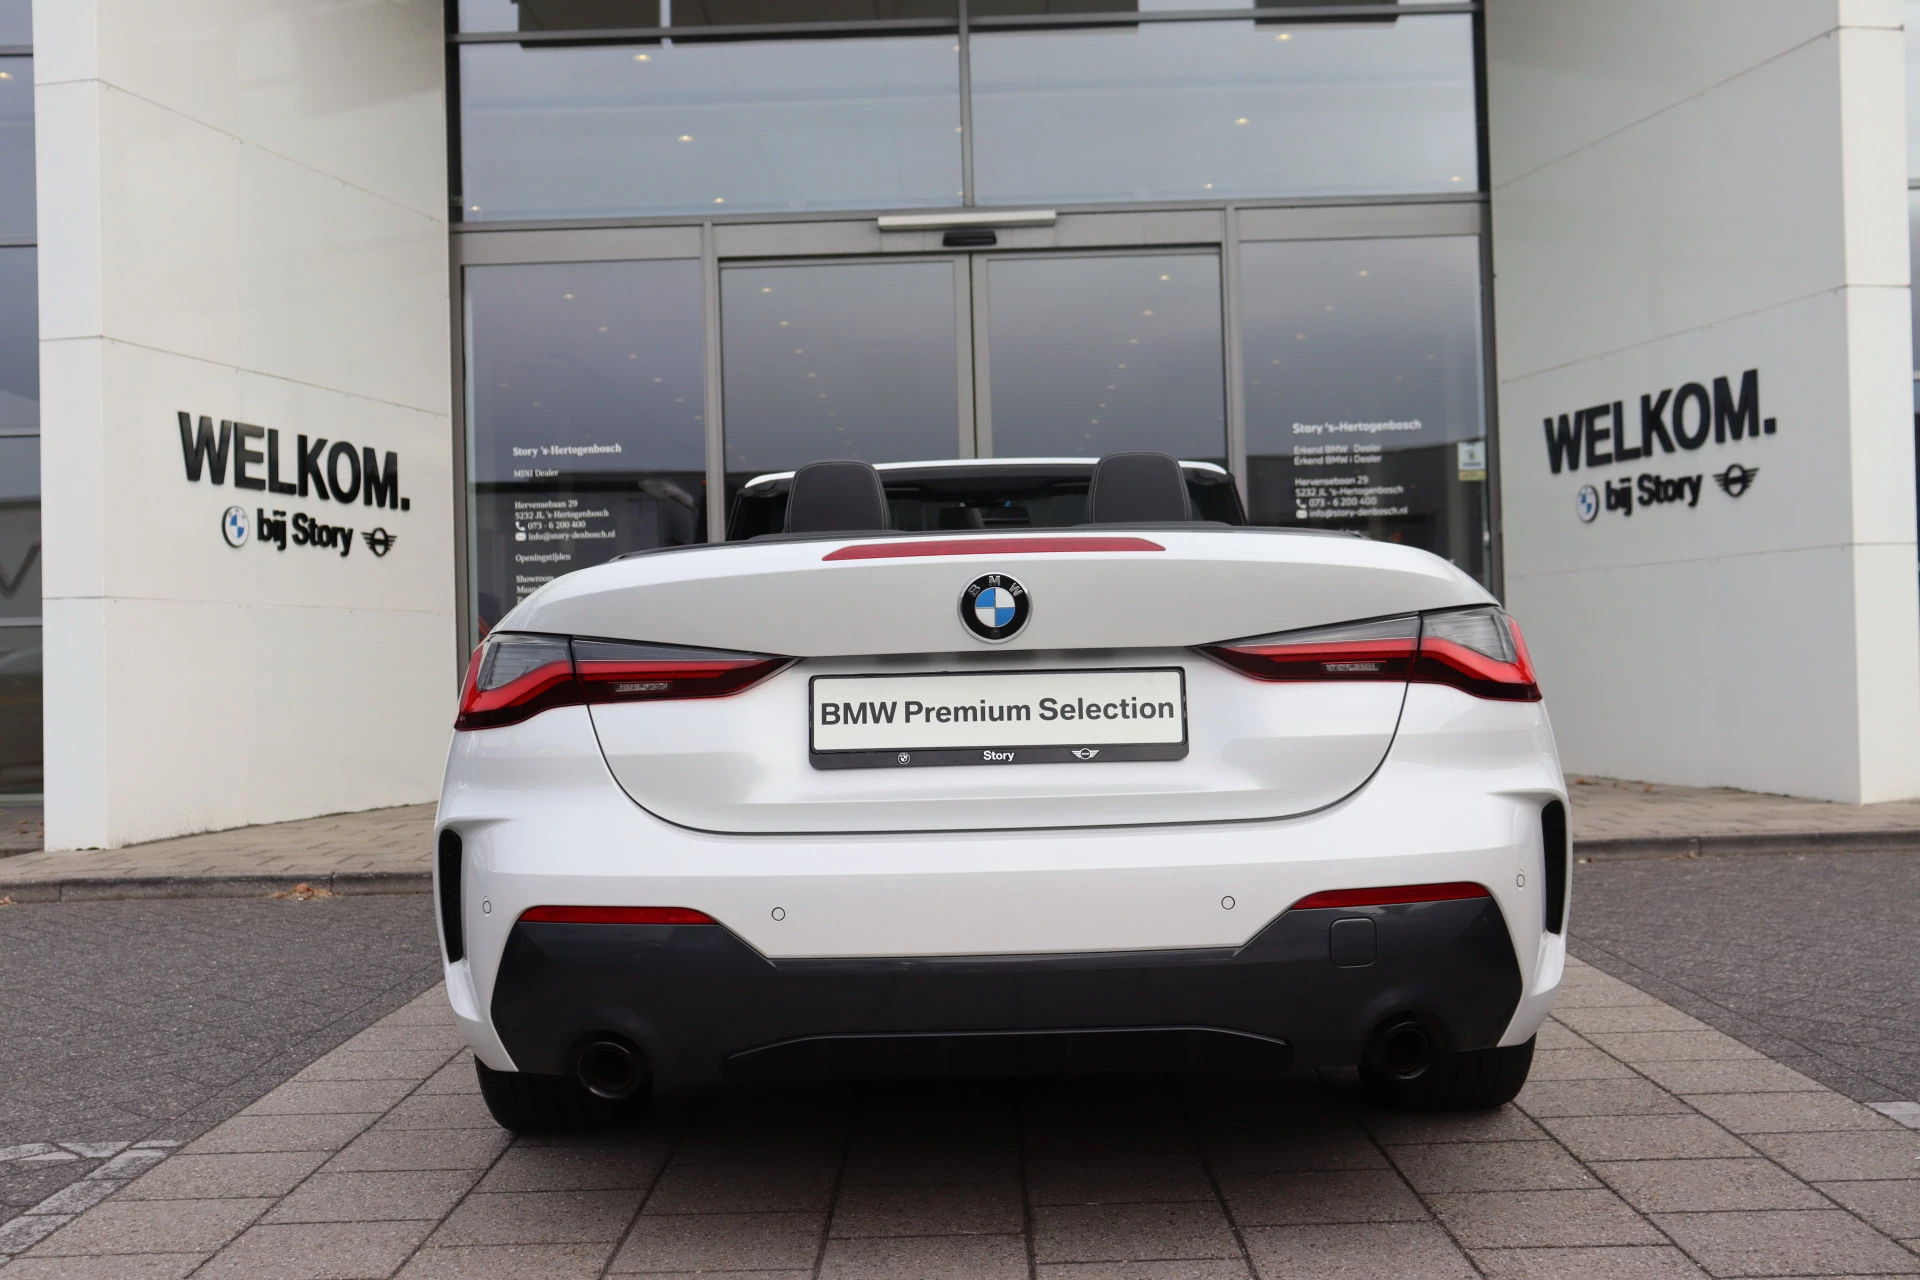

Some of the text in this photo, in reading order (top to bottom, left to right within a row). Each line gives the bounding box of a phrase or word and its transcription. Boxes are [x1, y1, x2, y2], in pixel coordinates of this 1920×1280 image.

[1543, 368, 1777, 475] WELKOM.
[1292, 422, 1323, 435] Story
[512, 446, 538, 458] Story
[1293, 443, 1381, 455] Erkend BMW Dealer
[177, 411, 411, 511] WELKOM.
[1294, 456, 1324, 466] Erkend
[1325, 455, 1348, 465] BMW
[1354, 454, 1382, 464] Dealer
[514, 468, 559, 478] MINI Dealer
[1357, 475, 1369, 485] 29
[1295, 488, 1316, 497] 5232
[1605, 476, 1632, 517] bij
[1637, 473, 1703, 508] Story
[568, 499, 578, 508] 29
[1309, 498, 1325, 508] 073
[1341, 497, 1358, 507] 200
[1359, 496, 1377, 506] 400
[515, 511, 534, 520] 5232
[535, 511, 545, 519] JL
[527, 522, 542, 530] 073
[555, 520, 570, 529] 200
[571, 520, 586, 528] 400
[256, 508, 353, 557] bij Story
[515, 553, 571, 564] Openingstijden
[967, 575, 1024, 598] BMW
[821, 697, 1175, 726] BMW Premium Selection
[983, 749, 1015, 763] Story
